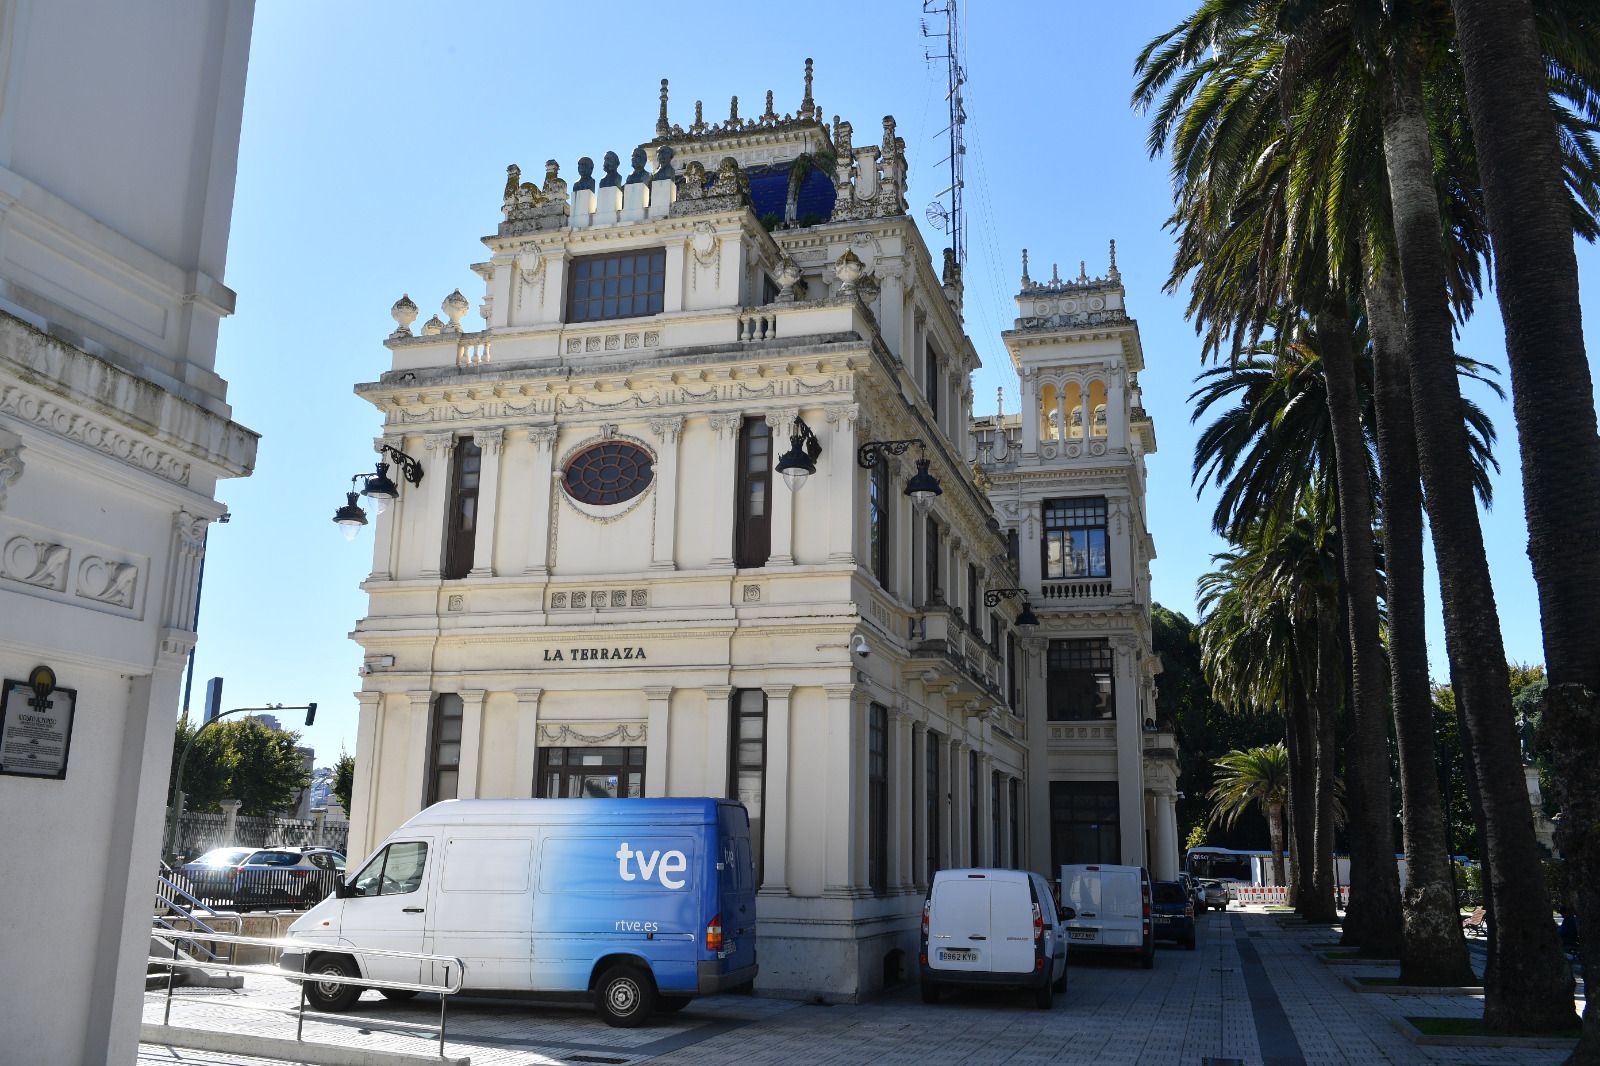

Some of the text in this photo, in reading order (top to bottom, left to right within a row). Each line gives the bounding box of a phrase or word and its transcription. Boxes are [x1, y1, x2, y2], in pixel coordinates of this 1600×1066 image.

[543, 647, 647, 661] LA TERRAZA
[616, 842, 687, 889] tve
[615, 920, 658, 932] rtve.es
